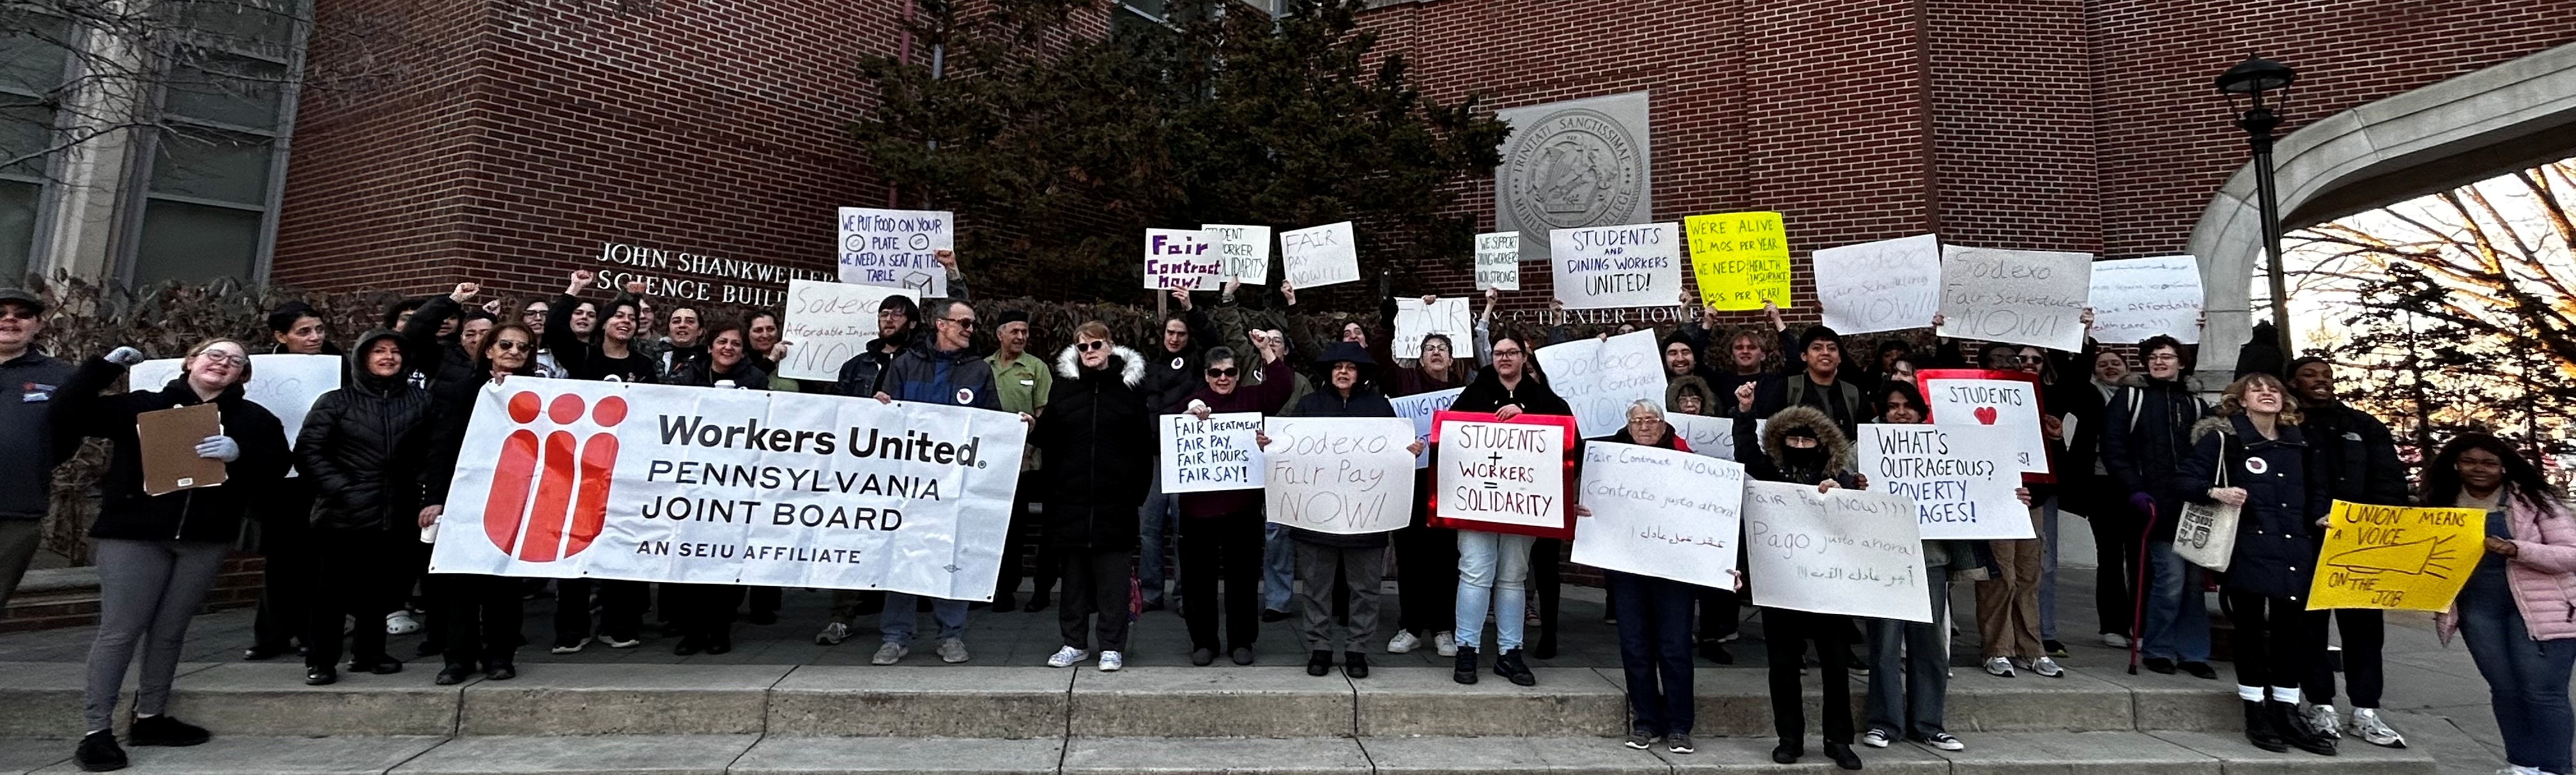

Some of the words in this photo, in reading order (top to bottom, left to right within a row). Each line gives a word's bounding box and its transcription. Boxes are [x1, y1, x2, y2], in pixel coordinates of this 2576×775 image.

[841, 214, 855, 232] WE
[858, 215, 871, 232] PUT
[874, 215, 895, 233] FOOD
[898, 219, 914, 232] ON
[916, 217, 942, 234] YOUR
[1689, 219, 1726, 236] WE'RE
[1738, 219, 1774, 233] ALIVE
[872, 237, 900, 250] PLATE
[1153, 234, 1208, 255] Fair
[1285, 229, 1337, 254] FAIR
[1572, 227, 1661, 251] STUDENTS
[1740, 241, 1755, 251] PER
[596, 243, 668, 269] JOHN
[1223, 243, 1253, 257] ORKER
[1604, 247, 1623, 256] AND
[839, 252, 852, 265] WE
[855, 252, 877, 266] NEED
[878, 254, 885, 266] A
[889, 252, 910, 266] SEAT
[912, 254, 923, 269] AT
[1288, 256, 1308, 271] PAY
[1567, 257, 1609, 273] DINING
[1614, 256, 1668, 270] WORKERS
[1713, 260, 1745, 275] NEED
[1749, 259, 1781, 272] HEALTH
[866, 269, 895, 282] TABLE
[1585, 273, 1651, 296] UNITED!
[1735, 291, 1751, 301] PER
[1397, 300, 1468, 335] FAIR
[1956, 308, 2058, 337] NOW!
[1553, 349, 1644, 379] Sodexo
[1950, 386, 2021, 406] STUDENTS
[1395, 399, 1429, 418] NING
[659, 415, 836, 455] Workers
[1174, 417, 1204, 438] FAIR
[1177, 438, 1206, 453] FAIR
[1280, 423, 1388, 455] Sodexo
[1458, 424, 1546, 453] STUDENTS
[1876, 427, 1949, 455] WHAT'S
[1178, 452, 1206, 466] FAIR
[1586, 446, 1611, 463] Fair
[1620, 447, 1672, 465] Contract
[1179, 468, 1210, 484] FAIR
[1214, 466, 1247, 483] SAY!
[1274, 460, 1325, 486] Fair
[1337, 459, 1384, 492] Pay
[1459, 461, 1535, 483] WORKERS
[1880, 456, 1994, 480] OUTRAGEOUS?
[647, 459, 940, 501] PENNSYLVANIA
[1280, 491, 1387, 528] NOW!
[1455, 486, 1552, 517] SOLIDARITY
[641, 496, 761, 524] JOINT
[772, 503, 902, 531] BOARD
[1920, 501, 1977, 524] AGES!
[2418, 511, 2468, 527] MEANS
[2333, 529, 2342, 540] A
[2358, 527, 2405, 546] VOICE
[636, 541, 670, 555] AN
[678, 542, 734, 558] SEIU
[743, 546, 861, 564] AFFILIATE
[2328, 572, 2350, 588] ON
[2348, 577, 2380, 590] THE
[2371, 589, 2405, 607] JOB
